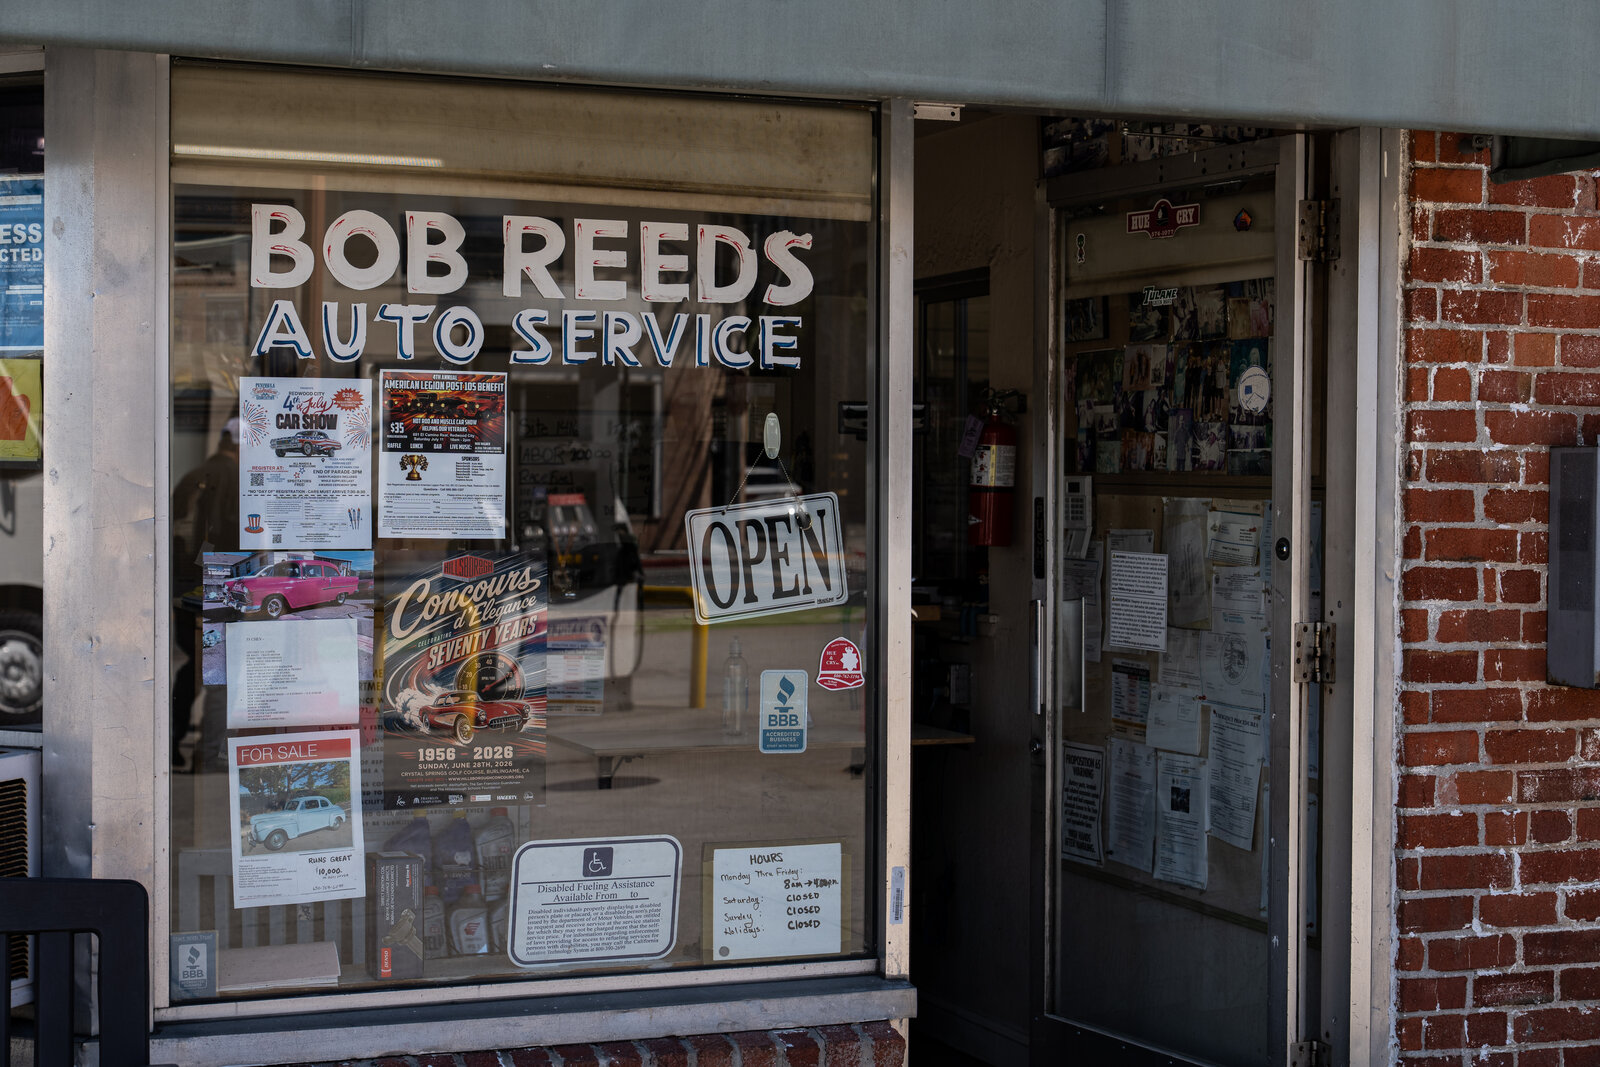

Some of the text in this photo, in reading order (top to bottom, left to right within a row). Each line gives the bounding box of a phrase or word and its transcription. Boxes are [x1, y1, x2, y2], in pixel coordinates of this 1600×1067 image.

[1131, 208, 1195, 230] HUE CRY
[250, 203, 814, 306] BOB REEDS
[250, 300, 802, 370] AUTO SERVICE
[384, 380, 420, 389] AMERICAN
[420, 381, 445, 390] LEGION
[446, 381, 463, 391] POST
[477, 382, 504, 392] BENEFIT
[302, 396, 334, 415] July
[275, 413, 338, 430] CAR SHOW
[390, 422, 404, 433] $35
[702, 509, 831, 609] OPEN
[391, 567, 541, 639] Concours
[417, 631, 452, 648] CELEBRATING
[427, 627, 491, 669] SEVENTY
[495, 615, 538, 646] YEARS
[768, 714, 799, 726] BBB
[241, 743, 317, 762] FOR SALE
[418, 745, 514, 761] 1956 2026
[418, 762, 450, 770] SUNDAY,
[308, 854, 352, 864] RUNS GREAT
[750, 853, 784, 865] HOURS
[720, 872, 751, 885] Monday
[784, 879, 803, 889] 8am
[538, 880, 655, 893] Disabled Fueling Assistance
[553, 891, 638, 902] Available From to
[606, 903, 633, 911] displaying
[183, 970, 204, 979] BBB
